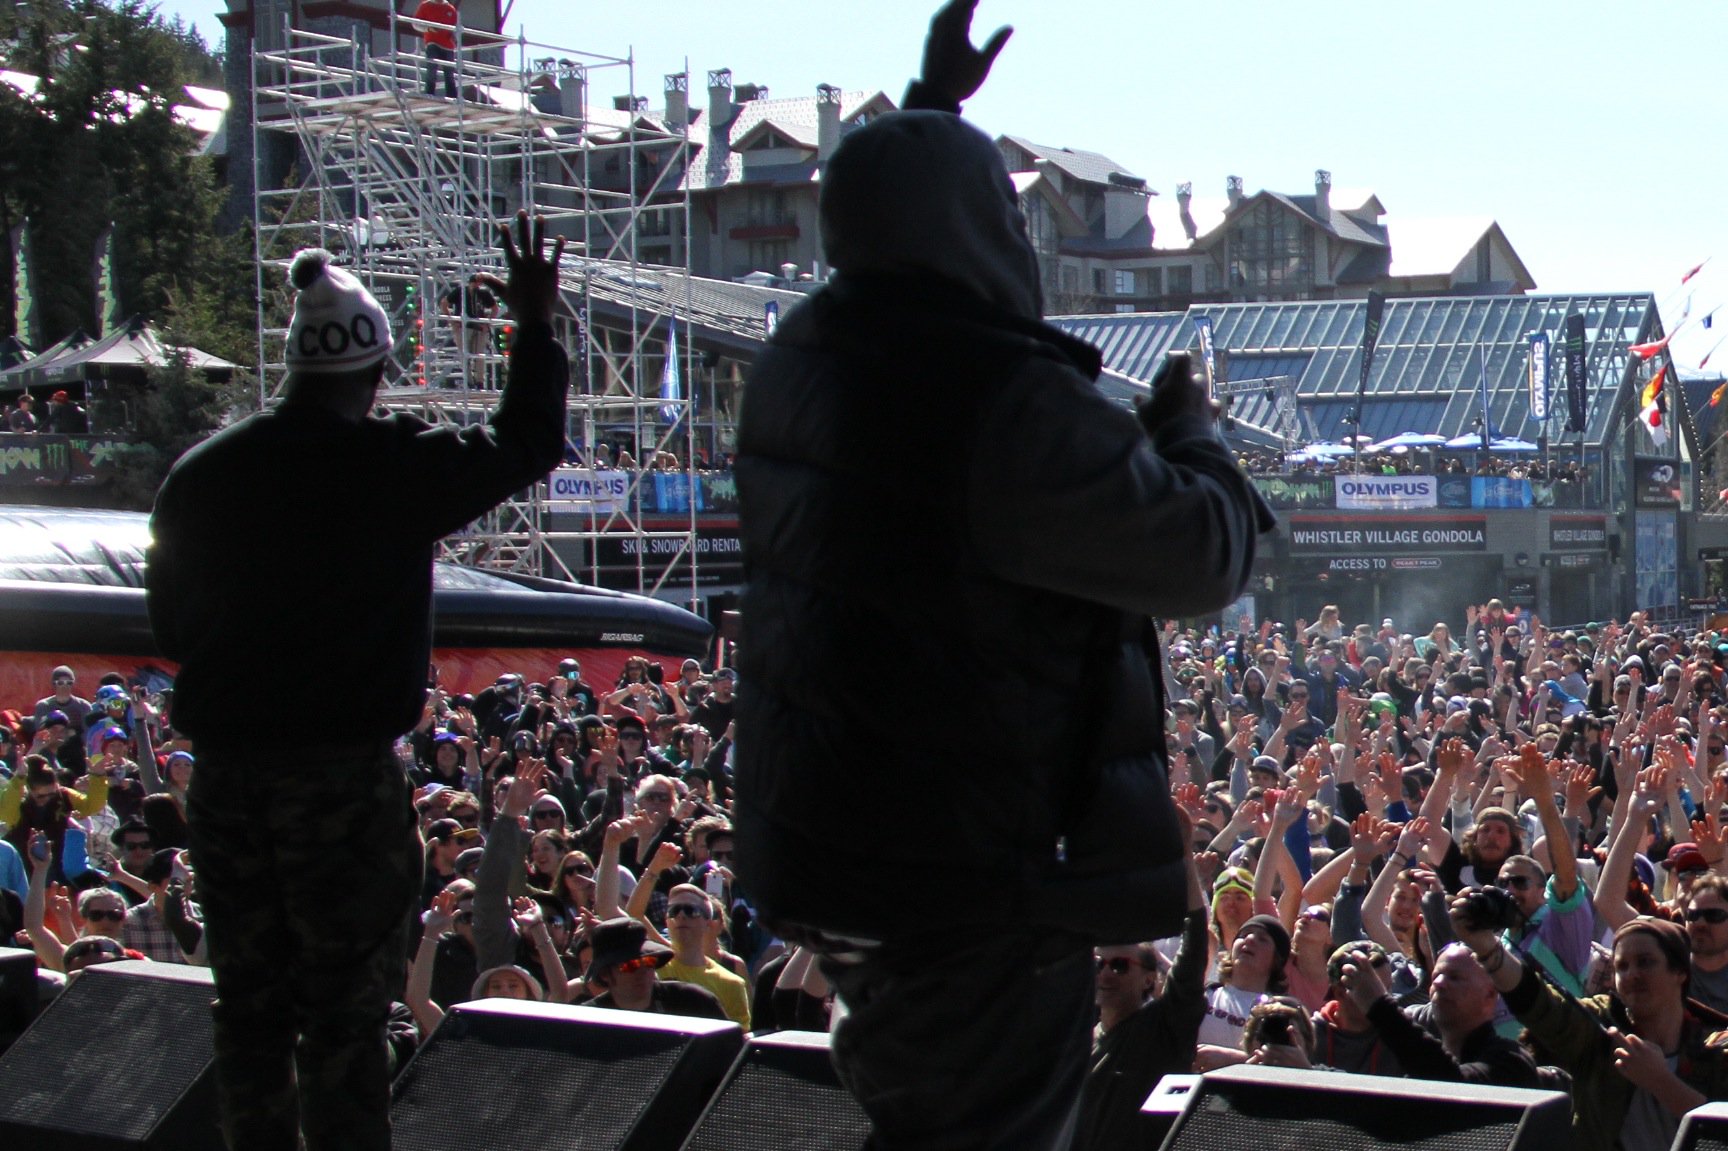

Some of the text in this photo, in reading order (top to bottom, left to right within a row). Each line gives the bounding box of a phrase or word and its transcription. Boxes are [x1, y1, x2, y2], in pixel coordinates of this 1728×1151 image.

[1341, 481, 1430, 496] OLYMPUS
[1293, 529, 1484, 544] WHISTLER VILLAGE GONDOLA
[641, 539, 649, 553] &
[712, 538, 741, 552] RENTA
[1329, 558, 1387, 569] ACCESS TO
